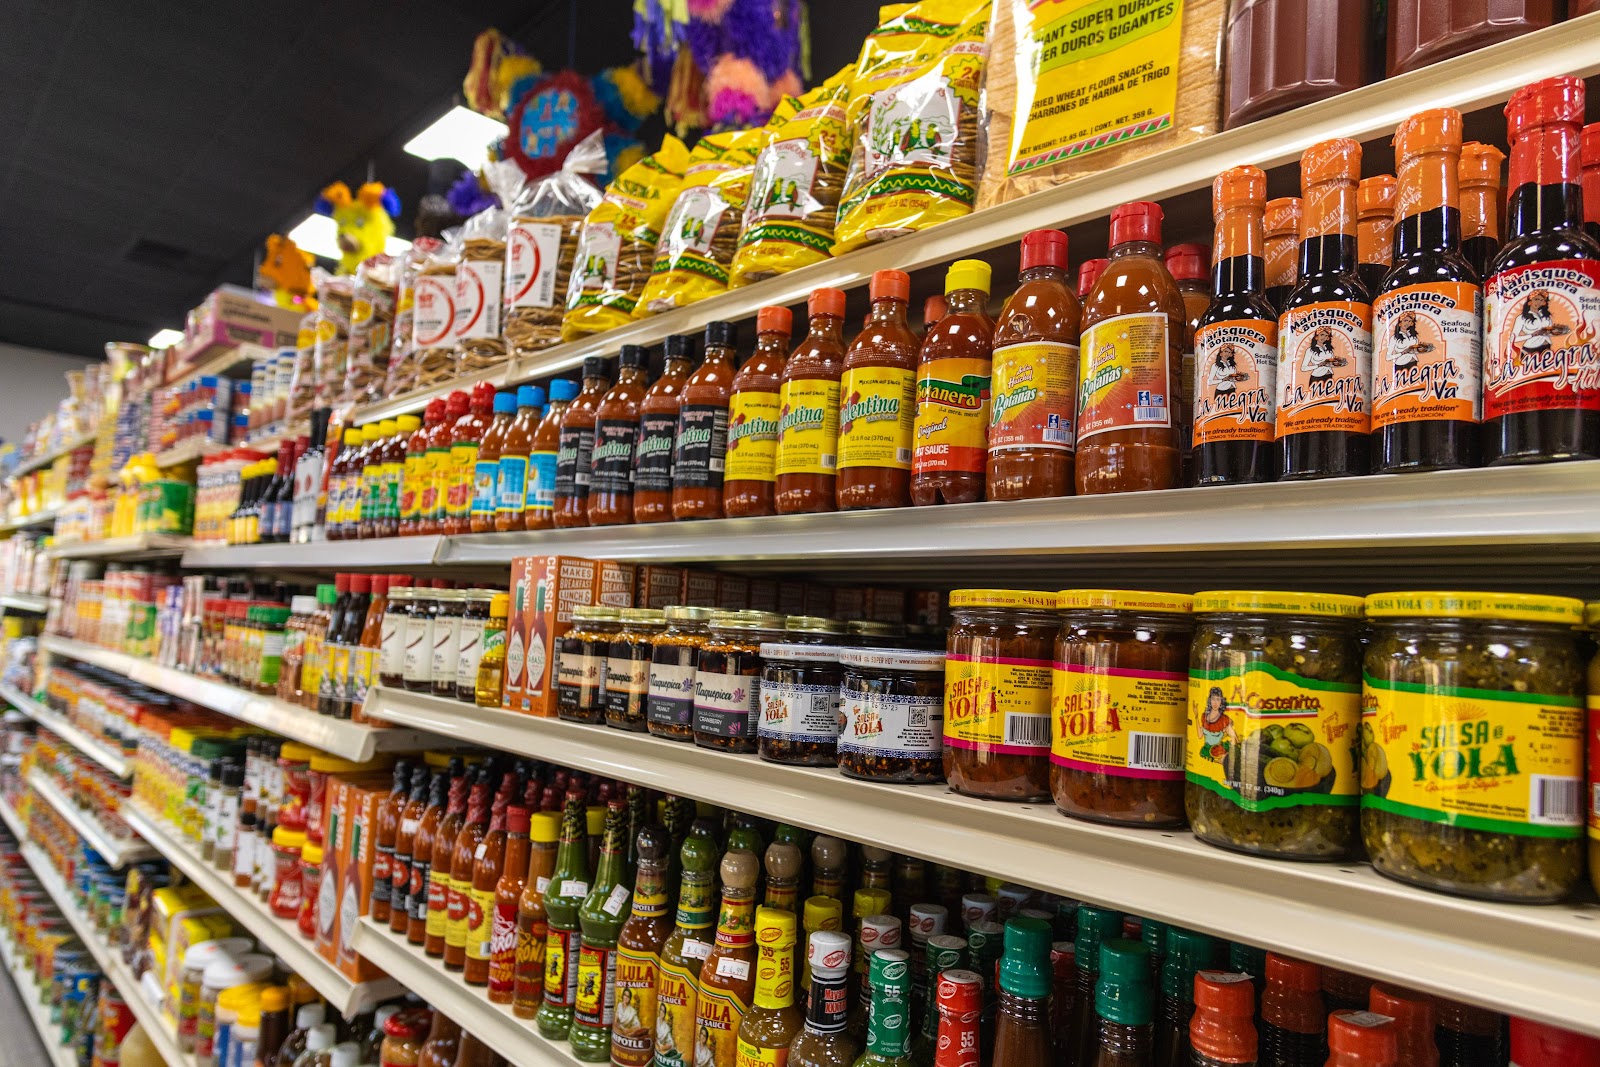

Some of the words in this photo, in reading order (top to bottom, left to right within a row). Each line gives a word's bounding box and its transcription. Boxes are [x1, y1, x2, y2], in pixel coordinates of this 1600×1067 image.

[1042, 24, 1067, 46] ANT
[1069, 8, 1113, 34] SUPER
[1118, 0, 1161, 19] DURO
[1061, 30, 1105, 55] DUROS
[1109, 2, 1175, 40] GIGANTES
[1031, 94, 1054, 109] FRIED
[1056, 87, 1087, 103] WHEAT
[1088, 75, 1116, 93] FLOUR
[1117, 60, 1154, 81] SNACKS
[1079, 95, 1090, 107] DE
[1092, 84, 1125, 105] HARINA
[1127, 77, 1138, 89] DE
[1141, 66, 1170, 86] TRIGO
[1019, 147, 1031, 156] NET
[1032, 138, 1058, 153] WEIGHT:
[1094, 119, 1114, 133] CONT.
[1115, 114, 1131, 126] NET.
[1496, 267, 1595, 301] Marisquera
[1512, 279, 1578, 299] Botanera
[1377, 291, 1457, 323] Marisquera
[1387, 302, 1442, 320] Botanera
[1290, 308, 1363, 334] Marisquera
[1302, 318, 1354, 334] Botanera
[1440, 319, 1471, 329] Seafood
[1443, 325, 1459, 334] Hot
[1200, 326, 1267, 350] Marisquera
[1208, 335, 1256, 350] Botanera
[1522, 343, 1596, 389] negra
[1395, 358, 1460, 402] negra
[917, 382, 977, 407] Botanera
[1310, 375, 1365, 413] negra
[992, 386, 1037, 427] Botanas
[1214, 386, 1269, 424] negra
[917, 416, 949, 440] Original
[1305, 417, 1332, 426] already
[871, 435, 881, 443] (370
[881, 435, 894, 443] mL)
[925, 444, 949, 455] SAUCE
[561, 567, 592, 578] MAKES
[603, 572, 632, 582] MAKES
[545, 556, 556, 613] CLASSIC
[560, 578, 592, 589] BREAKFAST
[560, 590, 583, 601] LUNCH
[1022, 596, 1044, 606] SALSA
[1310, 602, 1337, 613] SALSA
[952, 676, 982, 698] SALSA
[949, 691, 998, 721] YOLA
[1064, 689, 1102, 715] SALSA
[1246, 692, 1321, 711] Costeñita
[765, 706, 788, 721] YOLA
[1059, 706, 1122, 739] YOLA
[854, 718, 883, 736] YOLA
[1389, 725, 1408, 733] SUPER
[1421, 720, 1489, 750] SALSA
[1409, 743, 1521, 782] YOLA
[1263, 785, 1285, 796] (340g)
[780, 957, 790, 972] 55
[627, 981, 649, 989] SAUCE
[660, 977, 687, 999] LULA
[884, 984, 901, 998] 55
[663, 996, 682, 1006] SAUCE
[699, 1000, 732, 1023] LULA
[705, 1020, 726, 1030] SAUCE
[961, 1030, 975, 1048] 55
[656, 1054, 682, 1067] PEPPER
